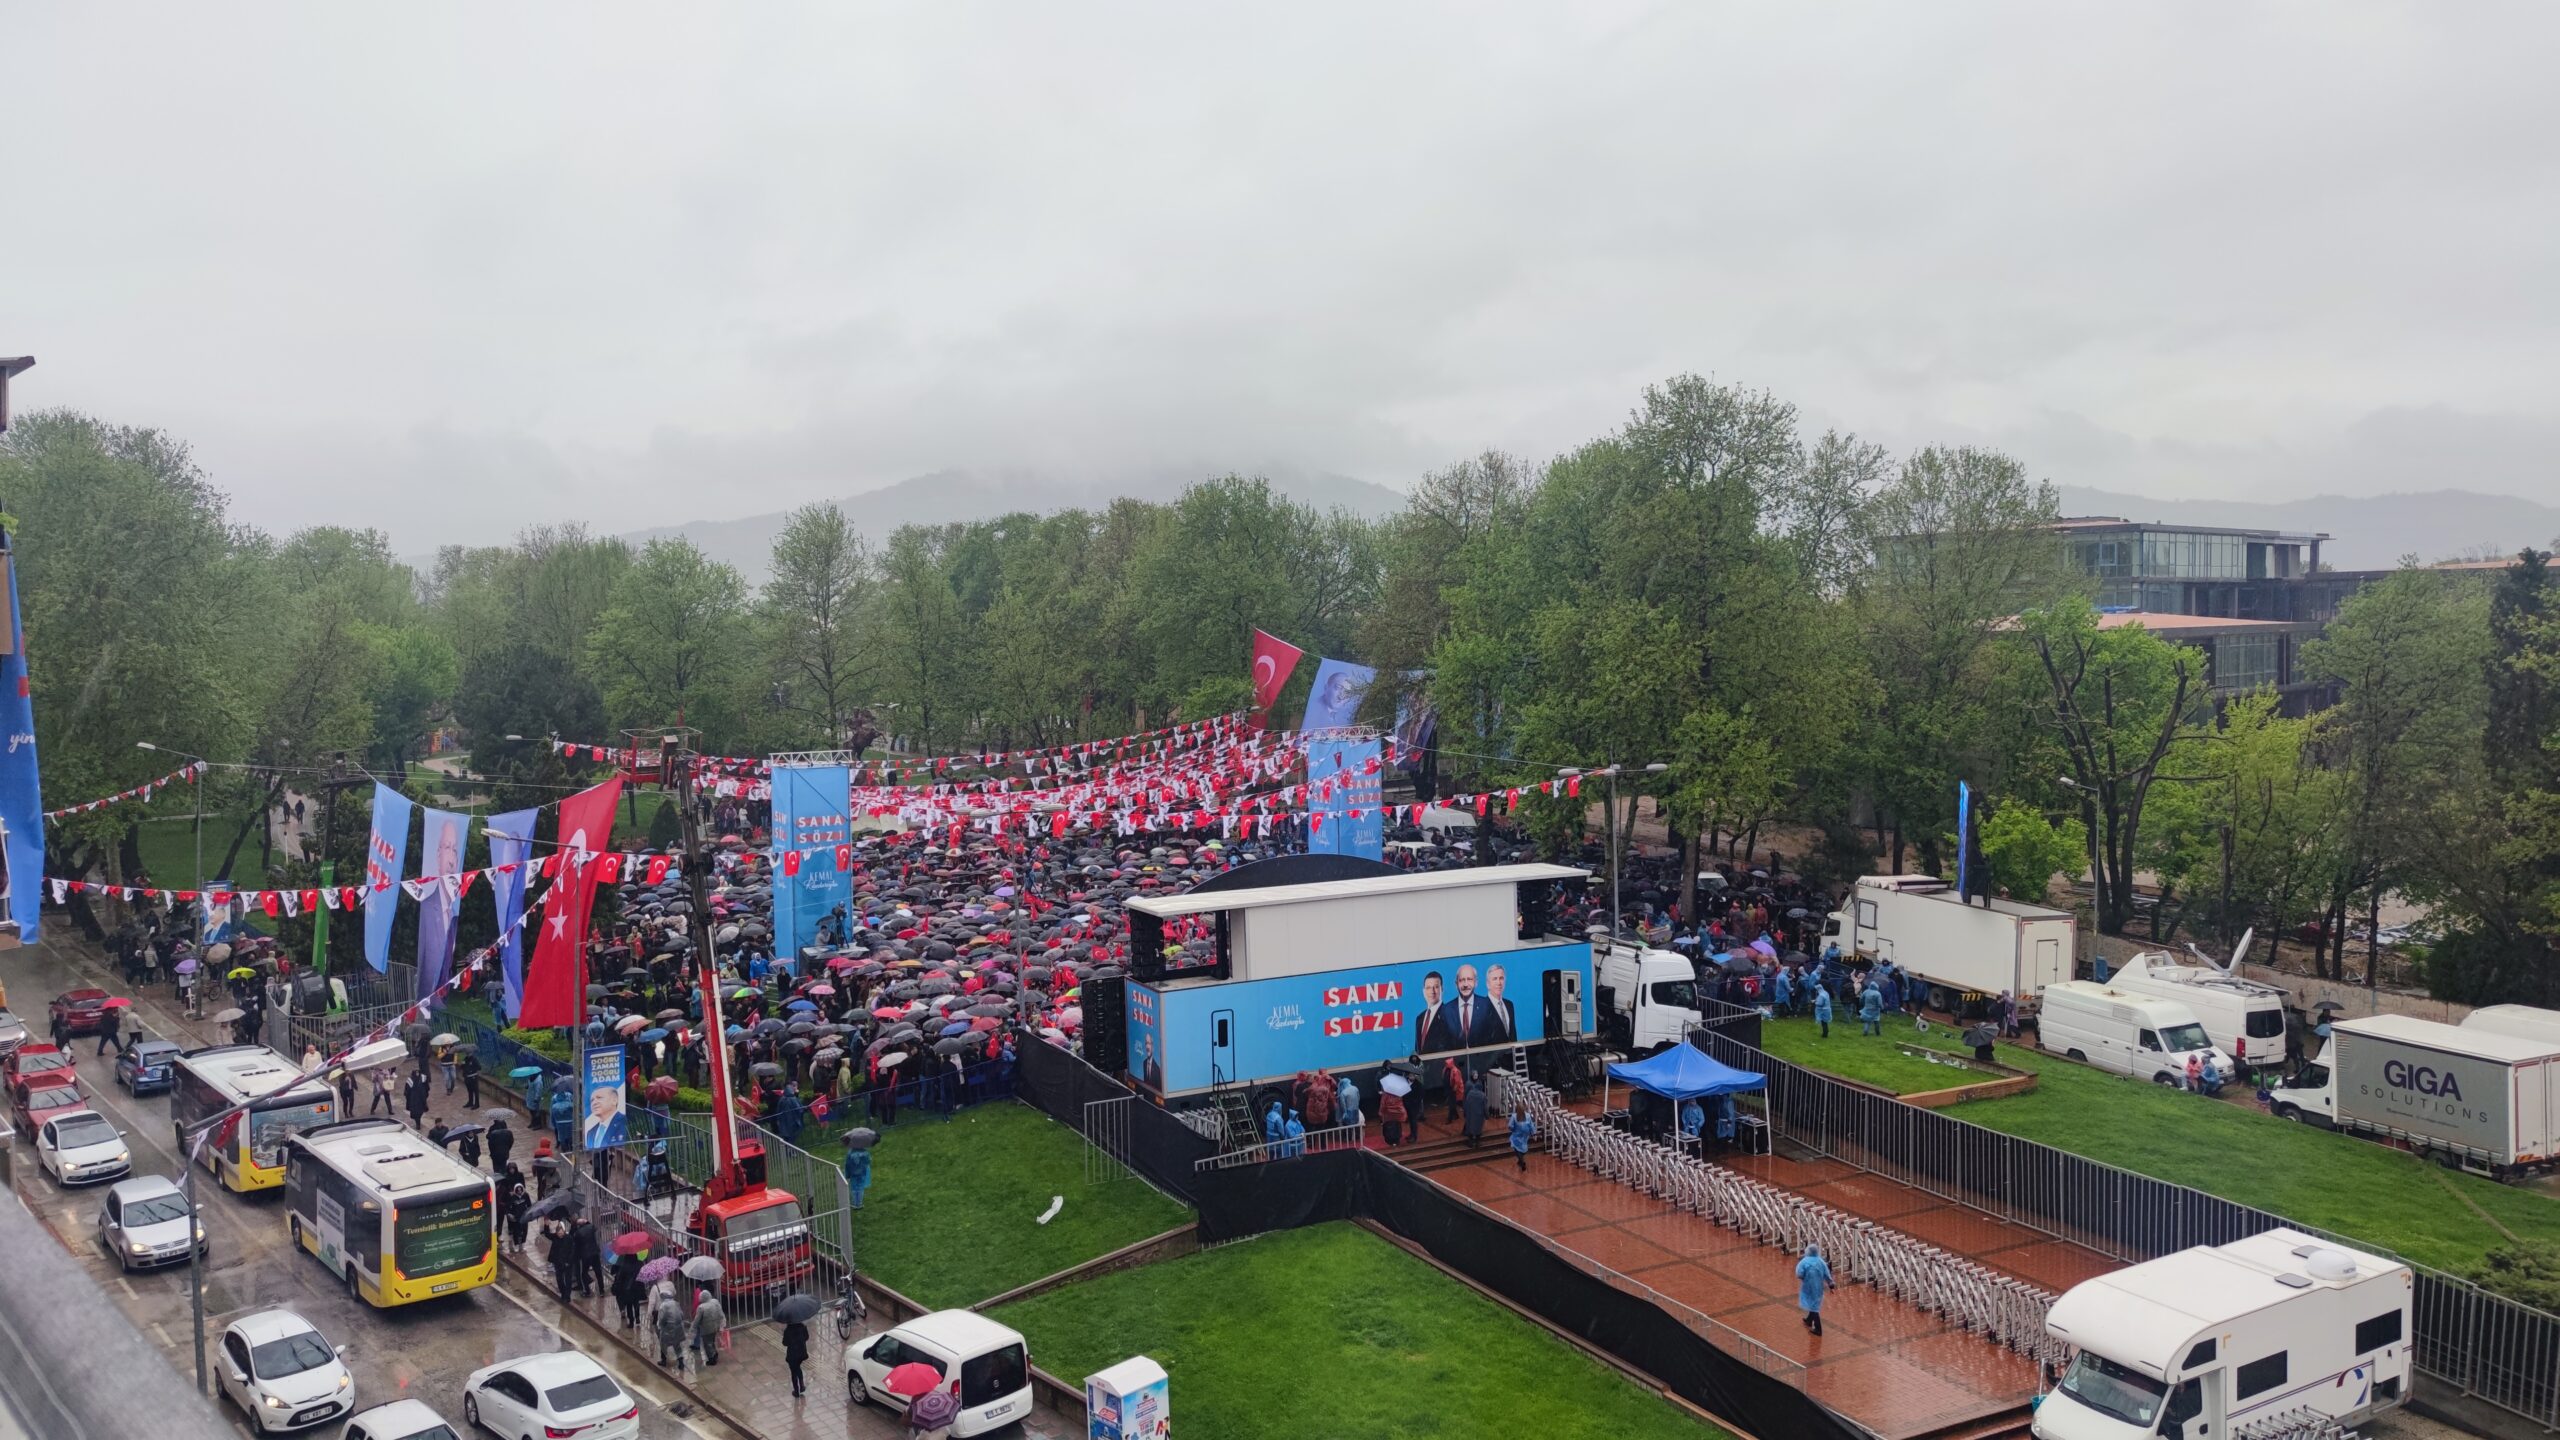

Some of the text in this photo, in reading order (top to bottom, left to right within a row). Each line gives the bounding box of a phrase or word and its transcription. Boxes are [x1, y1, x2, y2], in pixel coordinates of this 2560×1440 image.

[798, 814, 842, 828] SANA
[799, 829, 842, 843] SÖZ!
[1132, 990, 1152, 1009] SANA
[1327, 980, 1398, 1007] SANA
[1273, 1003, 1299, 1018] KEMAL
[1329, 1009, 1398, 1037] SÖZ!
[592, 1075, 620, 1084] ADAM
[2384, 1060, 2462, 1102] GIGA
[2360, 1084, 2488, 1123] SOLUTIONS
